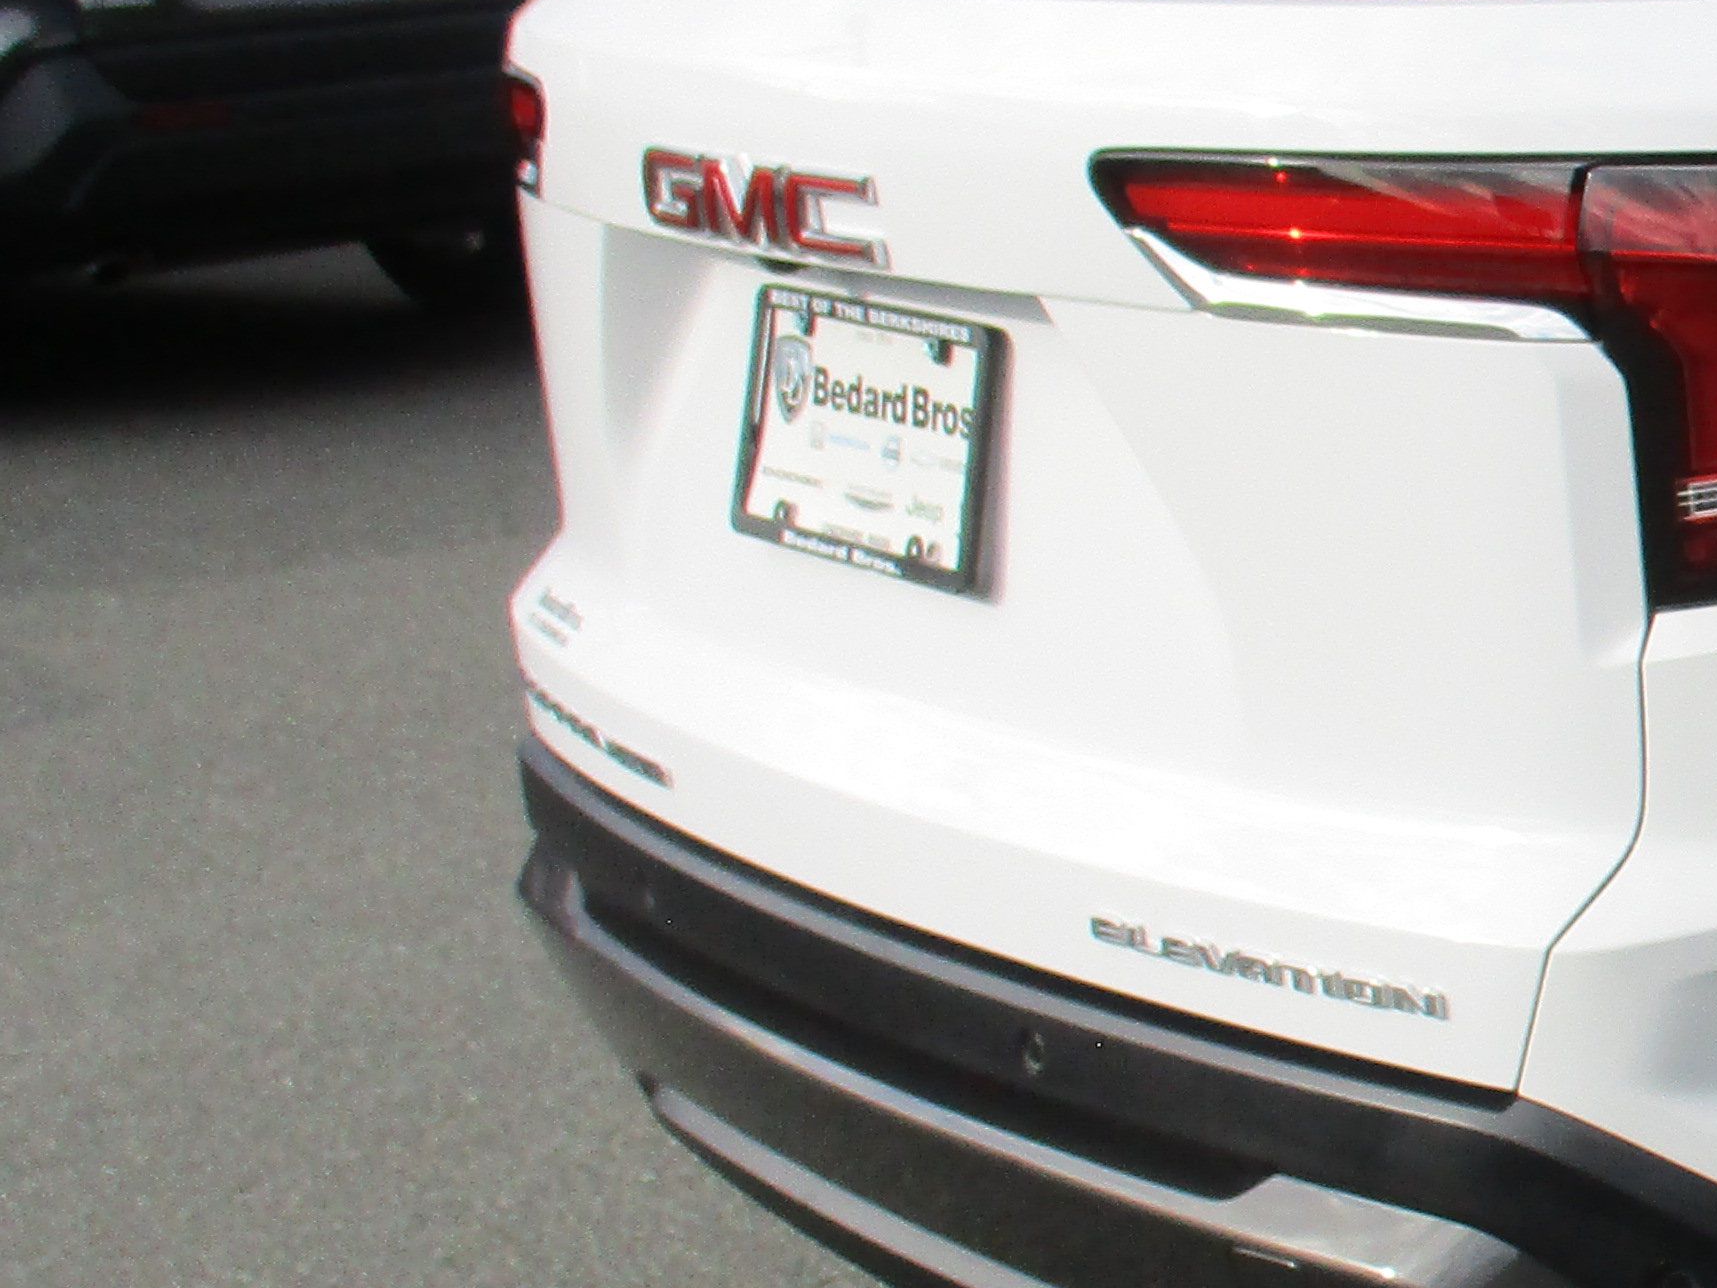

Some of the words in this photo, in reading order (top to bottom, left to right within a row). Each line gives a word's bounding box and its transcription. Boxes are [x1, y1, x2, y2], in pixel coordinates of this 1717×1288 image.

[642, 146, 894, 272] GMC
[812, 365, 910, 425] Bedard
[1090, 917, 1450, 1021] ELEVATION
